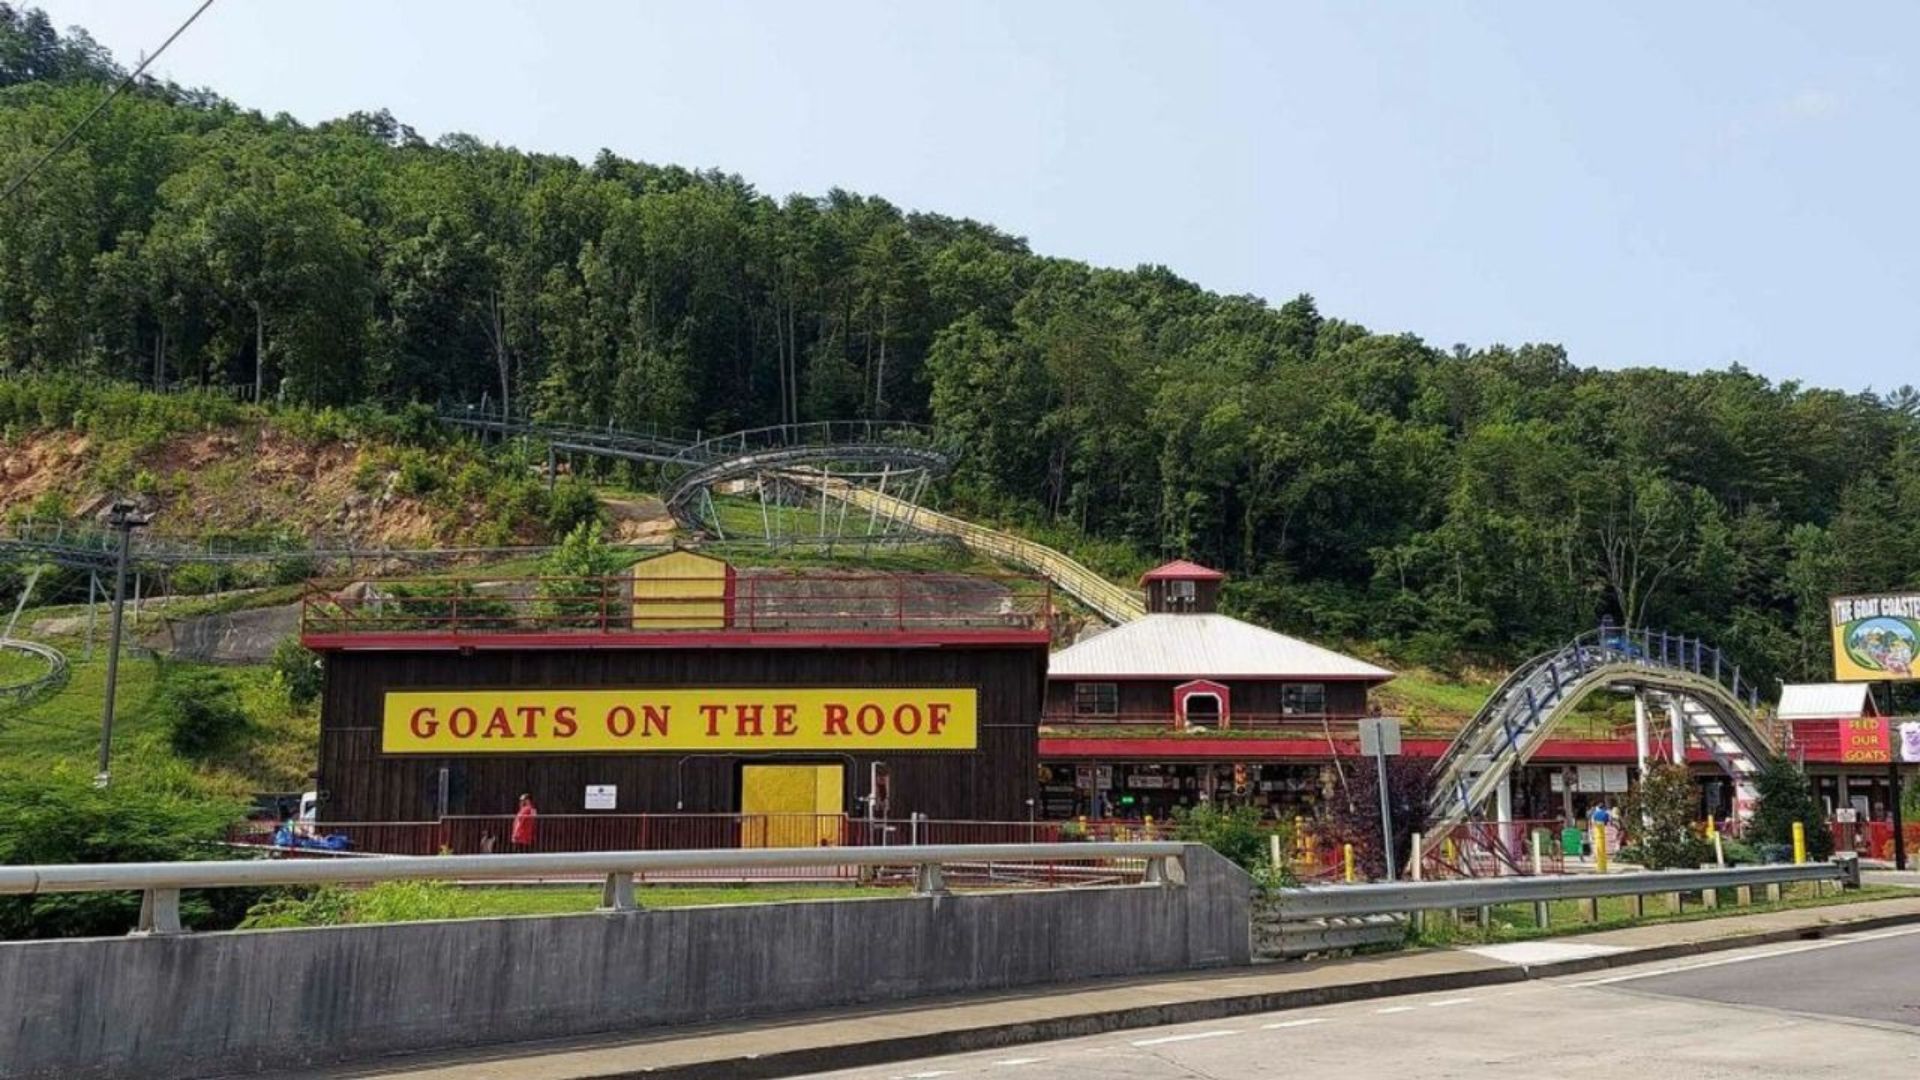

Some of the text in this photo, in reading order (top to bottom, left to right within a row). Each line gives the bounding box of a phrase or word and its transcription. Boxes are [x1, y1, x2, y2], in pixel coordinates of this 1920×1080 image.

[1834, 601, 1852, 625] THE
[1854, 599, 1880, 619] GOAT
[409, 702, 952, 740] GOATS ON THE ROOF
[1849, 719, 1879, 730] FEED
[1852, 734, 1879, 745] OUR
[1845, 750, 1888, 762] GOATS
